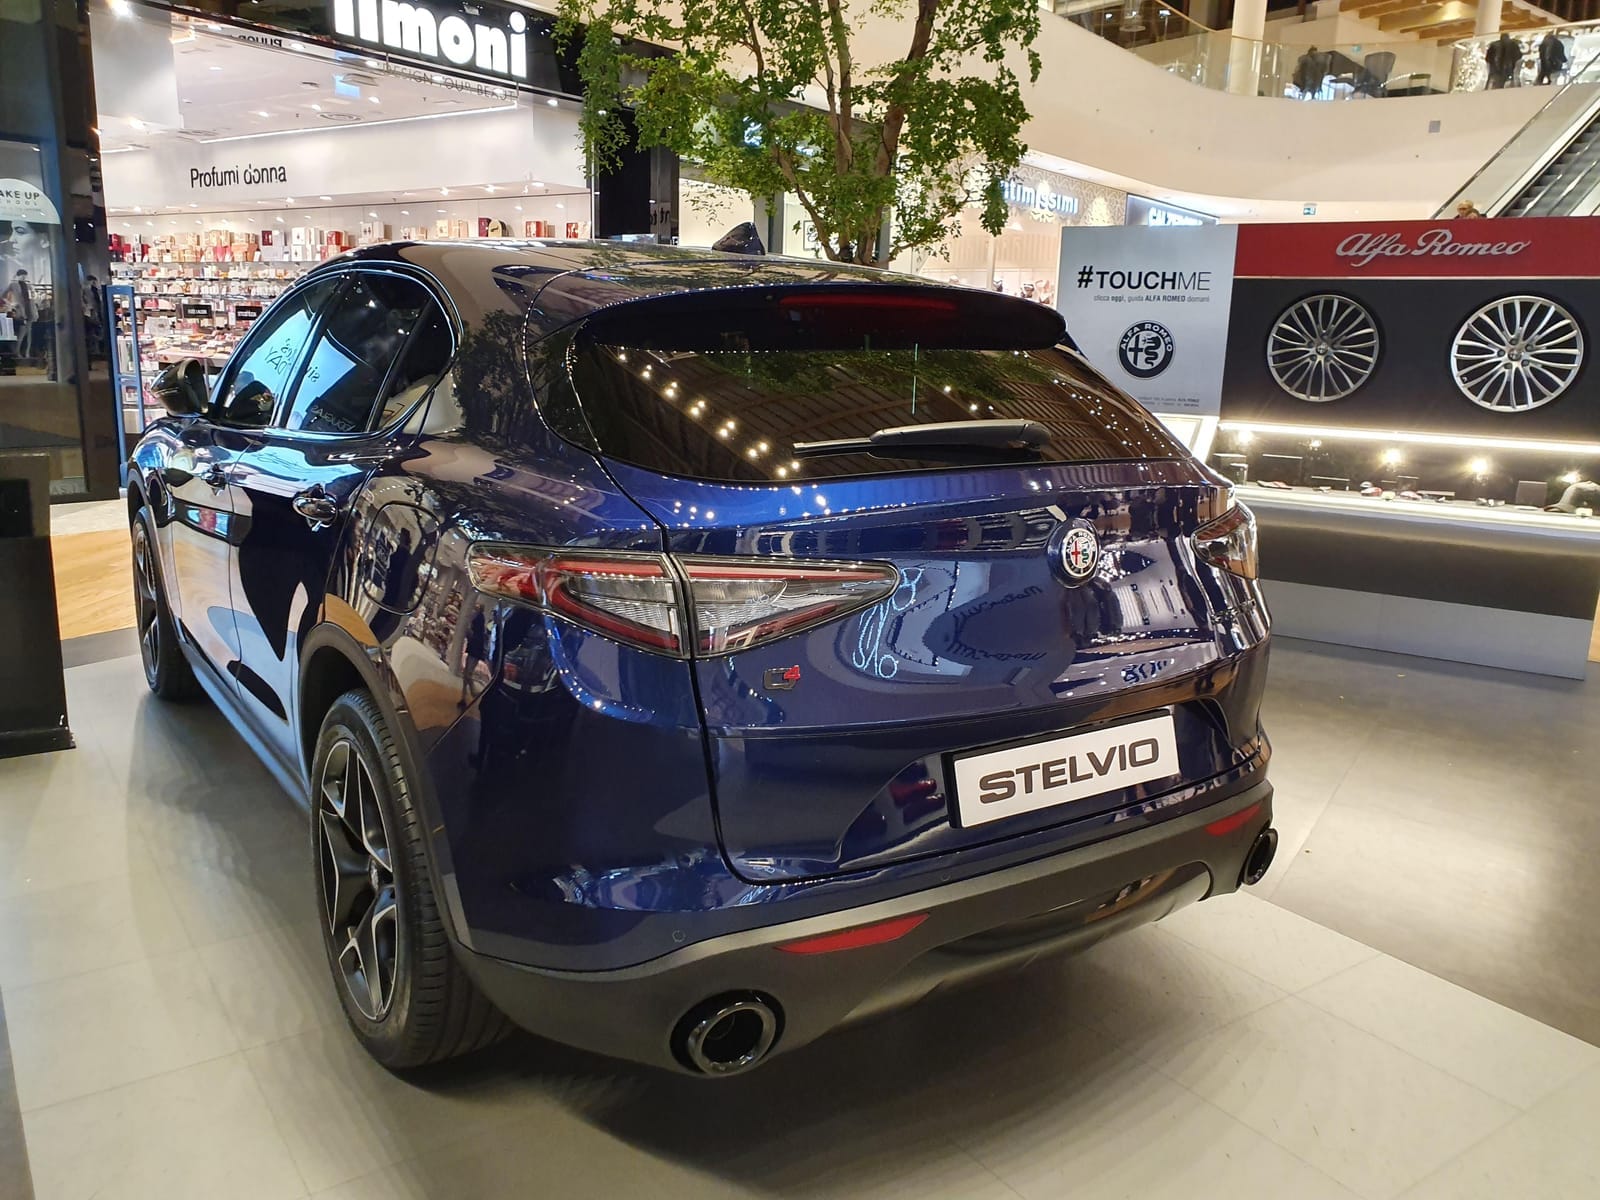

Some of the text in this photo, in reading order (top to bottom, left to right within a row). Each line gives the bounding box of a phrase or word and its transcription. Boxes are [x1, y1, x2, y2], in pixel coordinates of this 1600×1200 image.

[334, 0, 527, 78] limoni
[190, 163, 287, 188] Profumi donna
[0, 190, 40, 200] AKE UP
[1336, 229, 1531, 267] Alfa Romeo
[1162, 295, 1186, 303] ROMEO
[1121, 323, 1173, 352] ALFA ROMEO
[979, 737, 1160, 804] STELVIO
